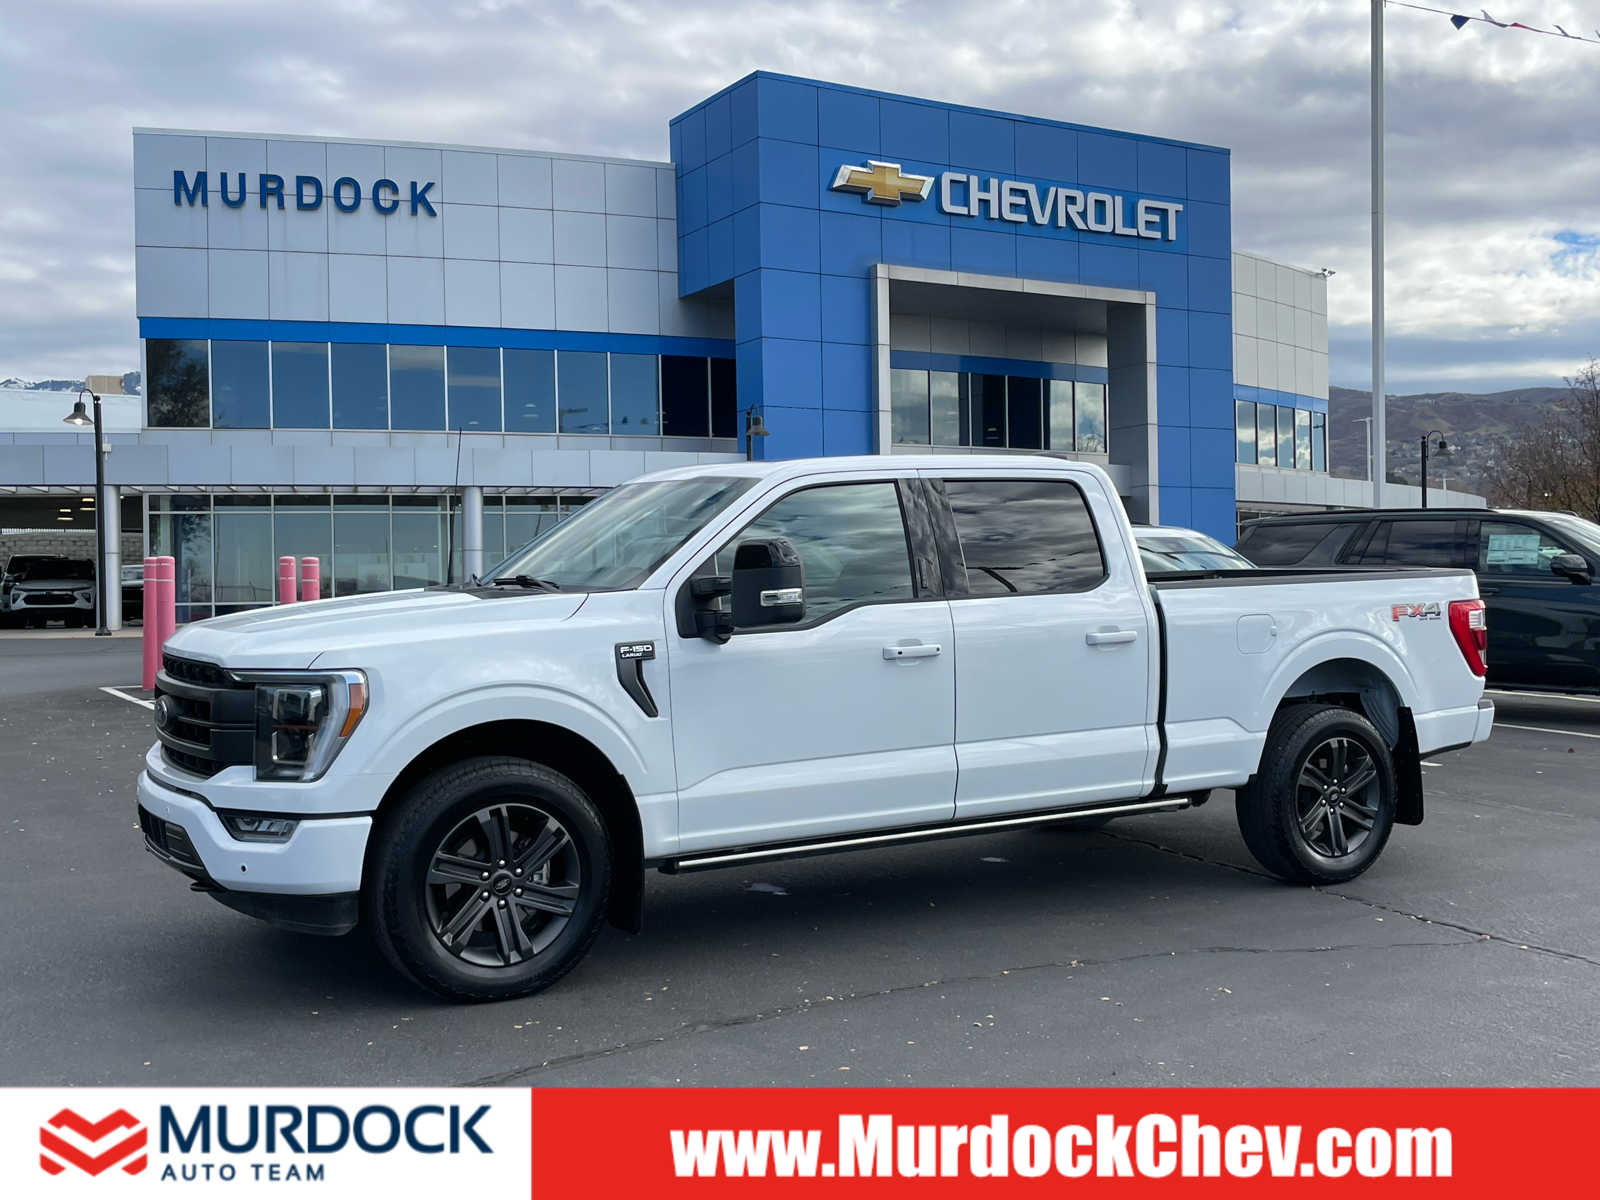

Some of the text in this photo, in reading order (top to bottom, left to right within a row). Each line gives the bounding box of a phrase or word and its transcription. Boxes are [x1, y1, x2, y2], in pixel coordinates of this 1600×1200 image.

[173, 170, 438, 217] MURDOCK
[940, 171, 1184, 241] CHEVROLET
[1391, 602, 1441, 621] FX4
[620, 645, 652, 653] F-150
